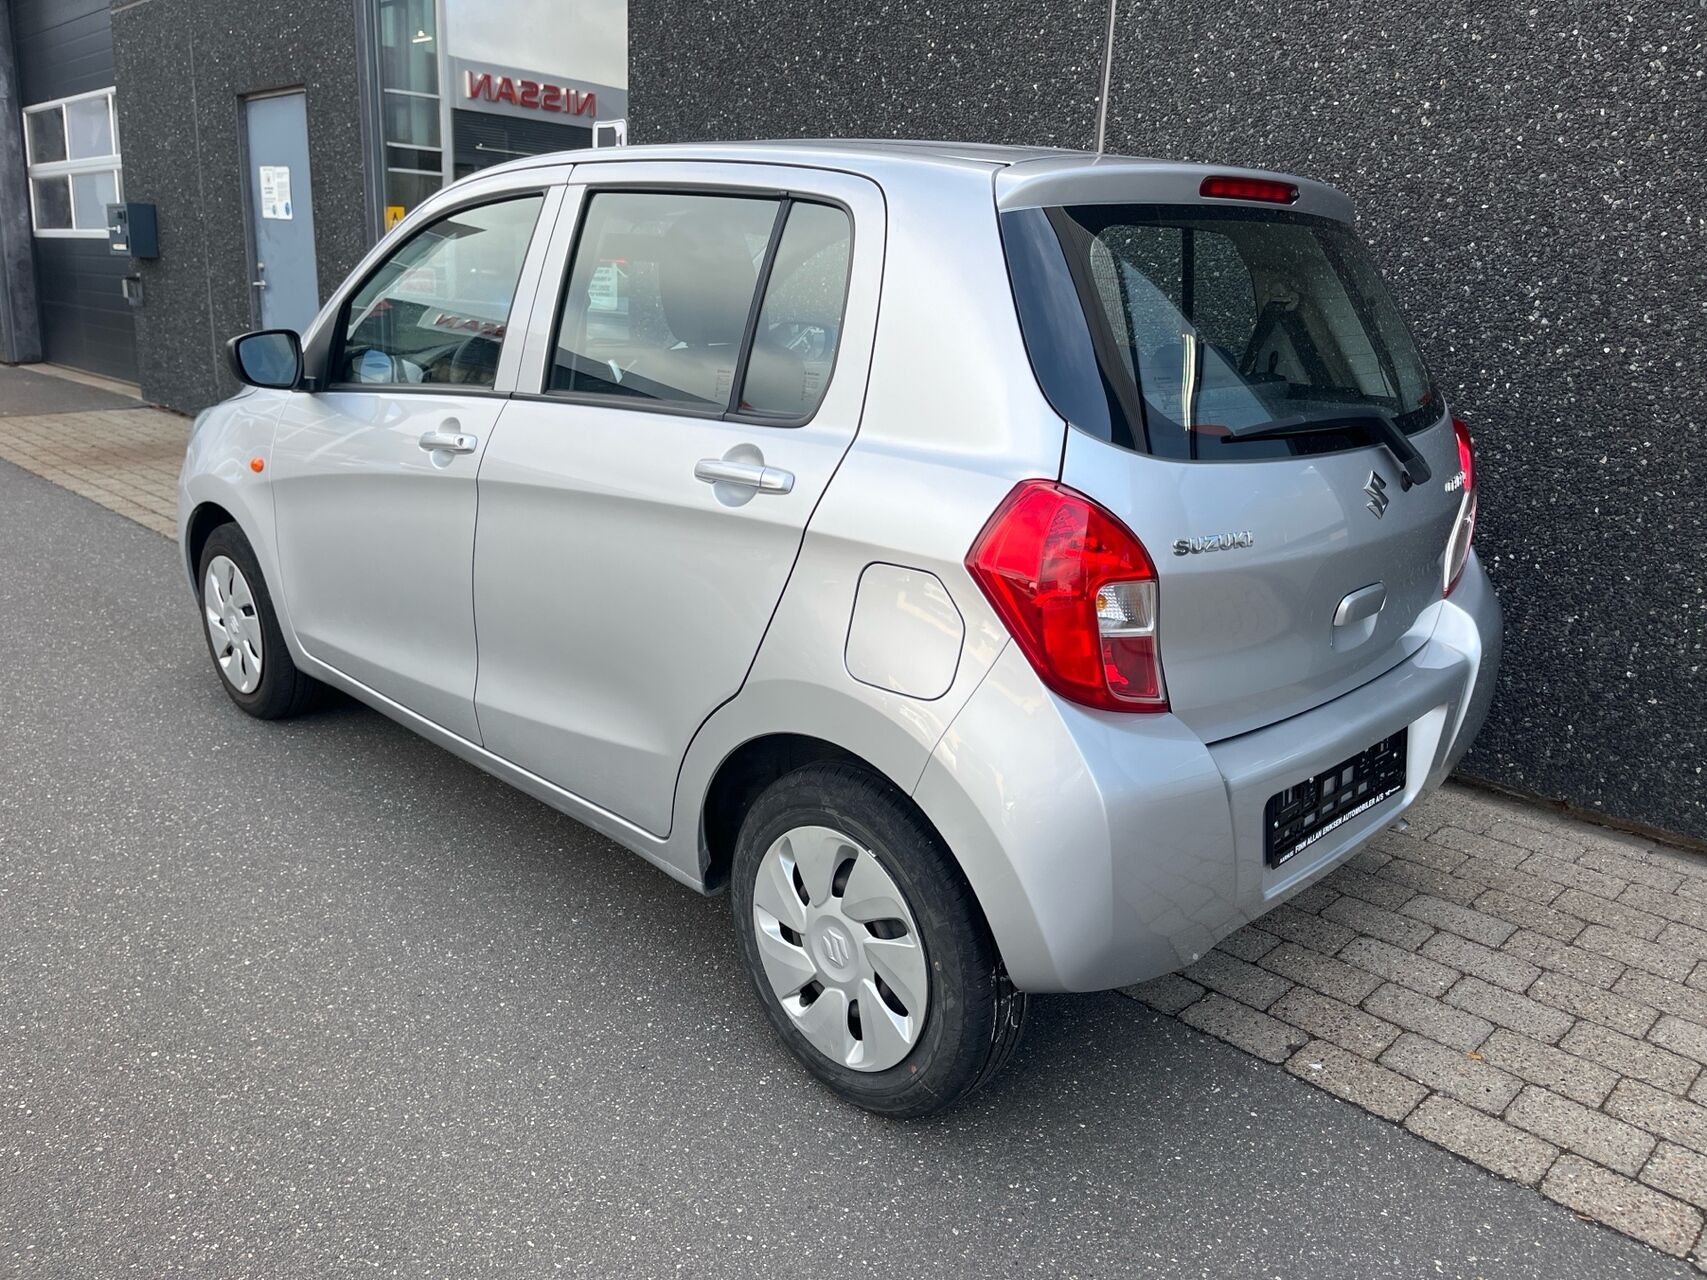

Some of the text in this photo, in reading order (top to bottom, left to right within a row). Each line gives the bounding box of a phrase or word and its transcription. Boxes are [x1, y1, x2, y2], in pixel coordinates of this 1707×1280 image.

[1173, 530, 1253, 556] SUZUKI
[1307, 829, 1322, 846] ALLAN
[1342, 797, 1375, 823] AUTOMOBILER
[1375, 792, 1384, 804] A/S
